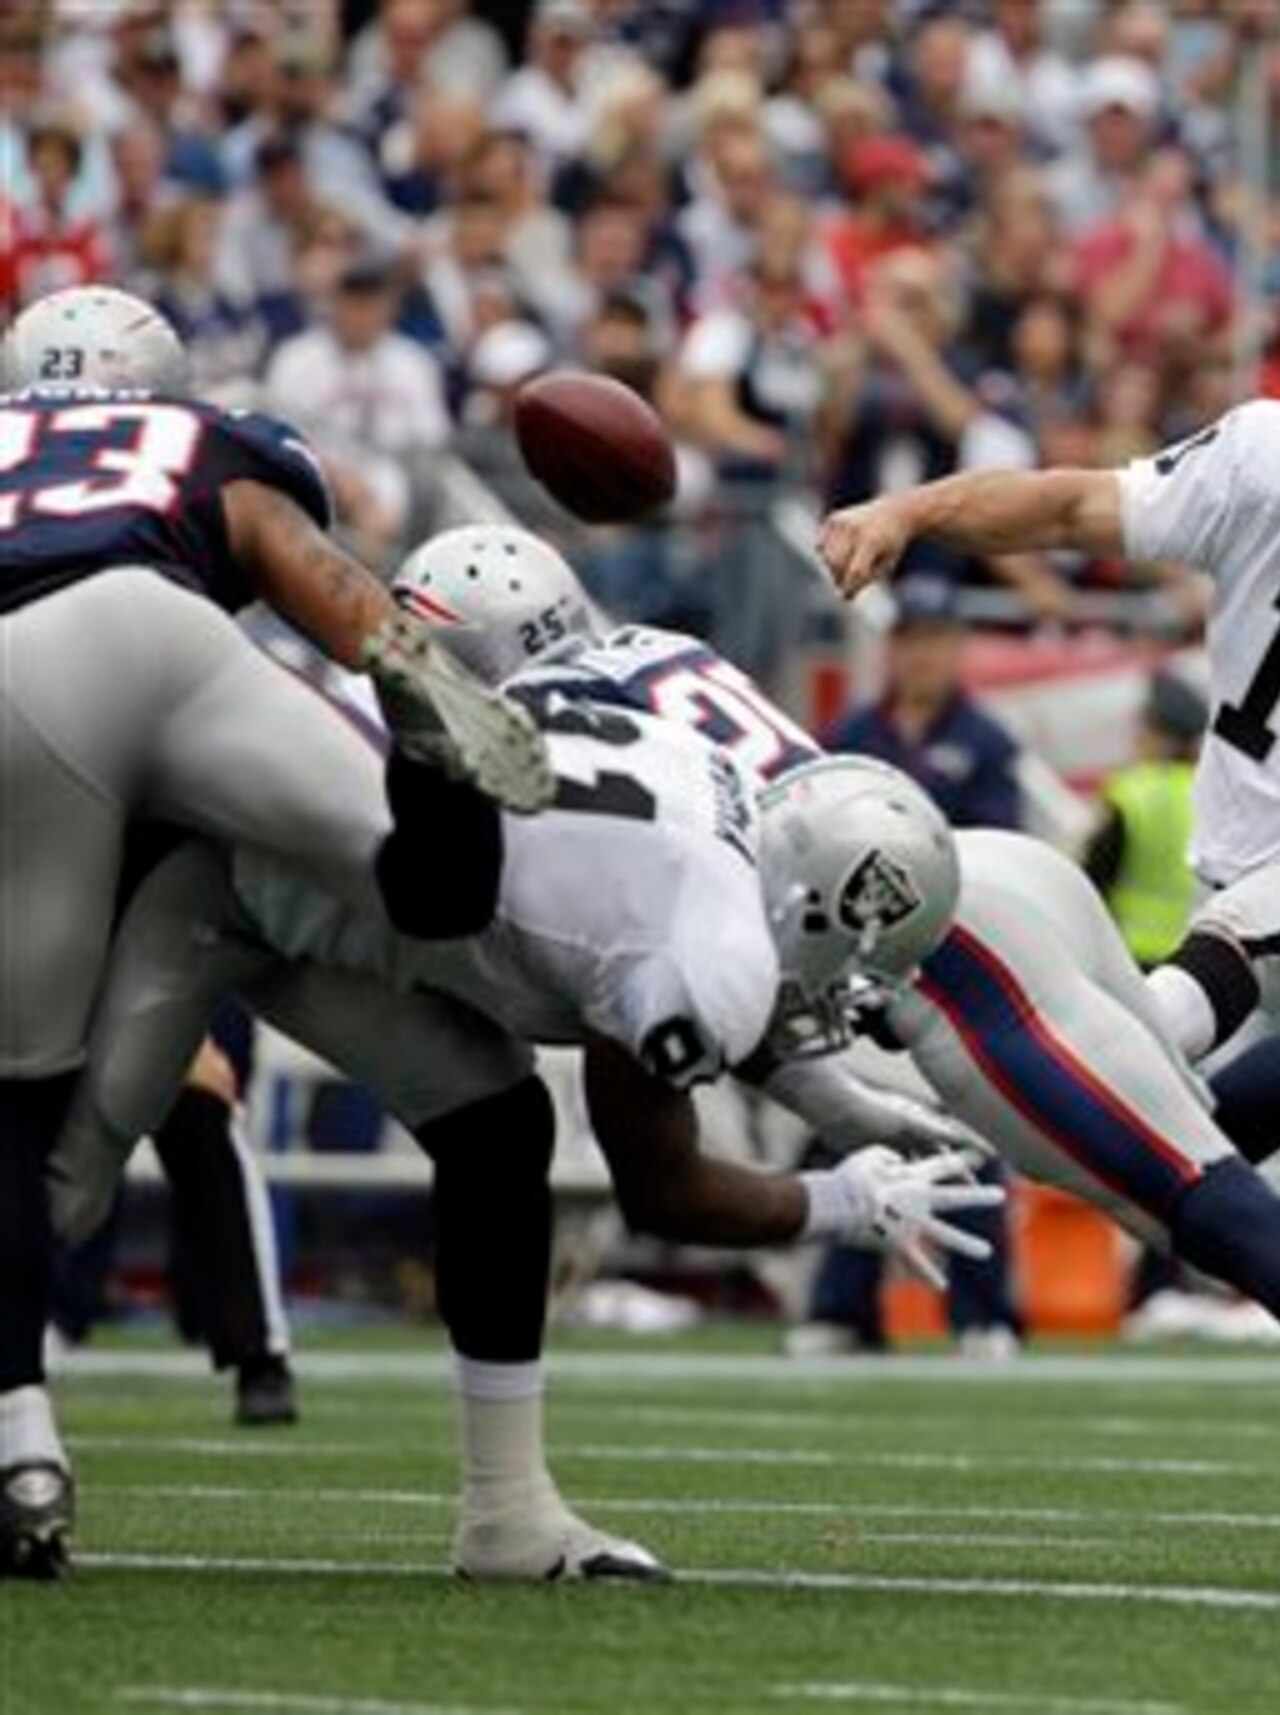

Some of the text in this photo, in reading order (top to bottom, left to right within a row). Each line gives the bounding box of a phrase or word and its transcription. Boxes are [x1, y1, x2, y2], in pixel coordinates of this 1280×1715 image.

[40, 347, 84, 379] 23
[0, 402, 202, 530] 3
[519, 605, 565, 656] 25
